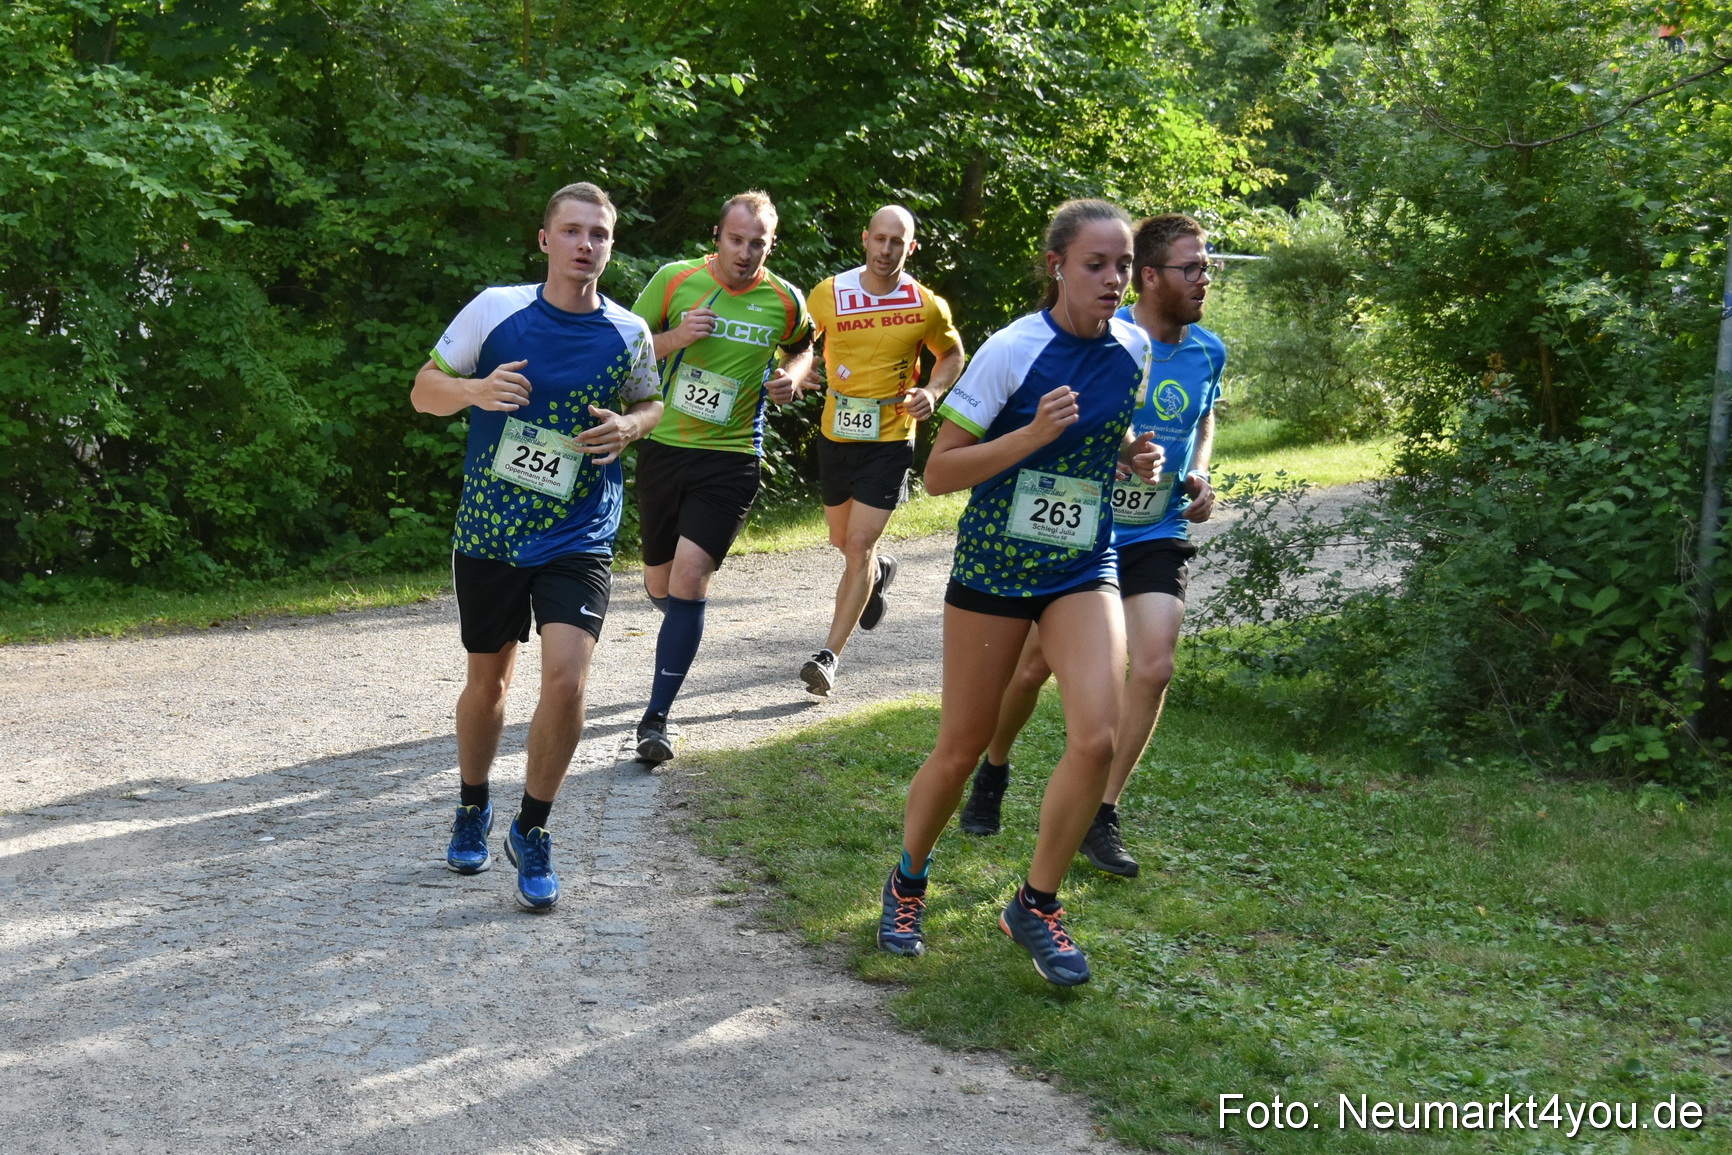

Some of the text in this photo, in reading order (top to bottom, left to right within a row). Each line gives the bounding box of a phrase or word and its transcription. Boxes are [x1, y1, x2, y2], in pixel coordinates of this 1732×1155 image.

[836, 312, 925, 333] MAX BÖGL
[685, 384, 720, 409] 324
[837, 411, 872, 429] 1548
[511, 445, 561, 478] 254
[504, 463, 540, 481] Oppermann
[541, 476, 561, 487] Simon
[1112, 488, 1157, 510] 987
[1029, 498, 1082, 529] 263
[1059, 527, 1075, 536] Julia
